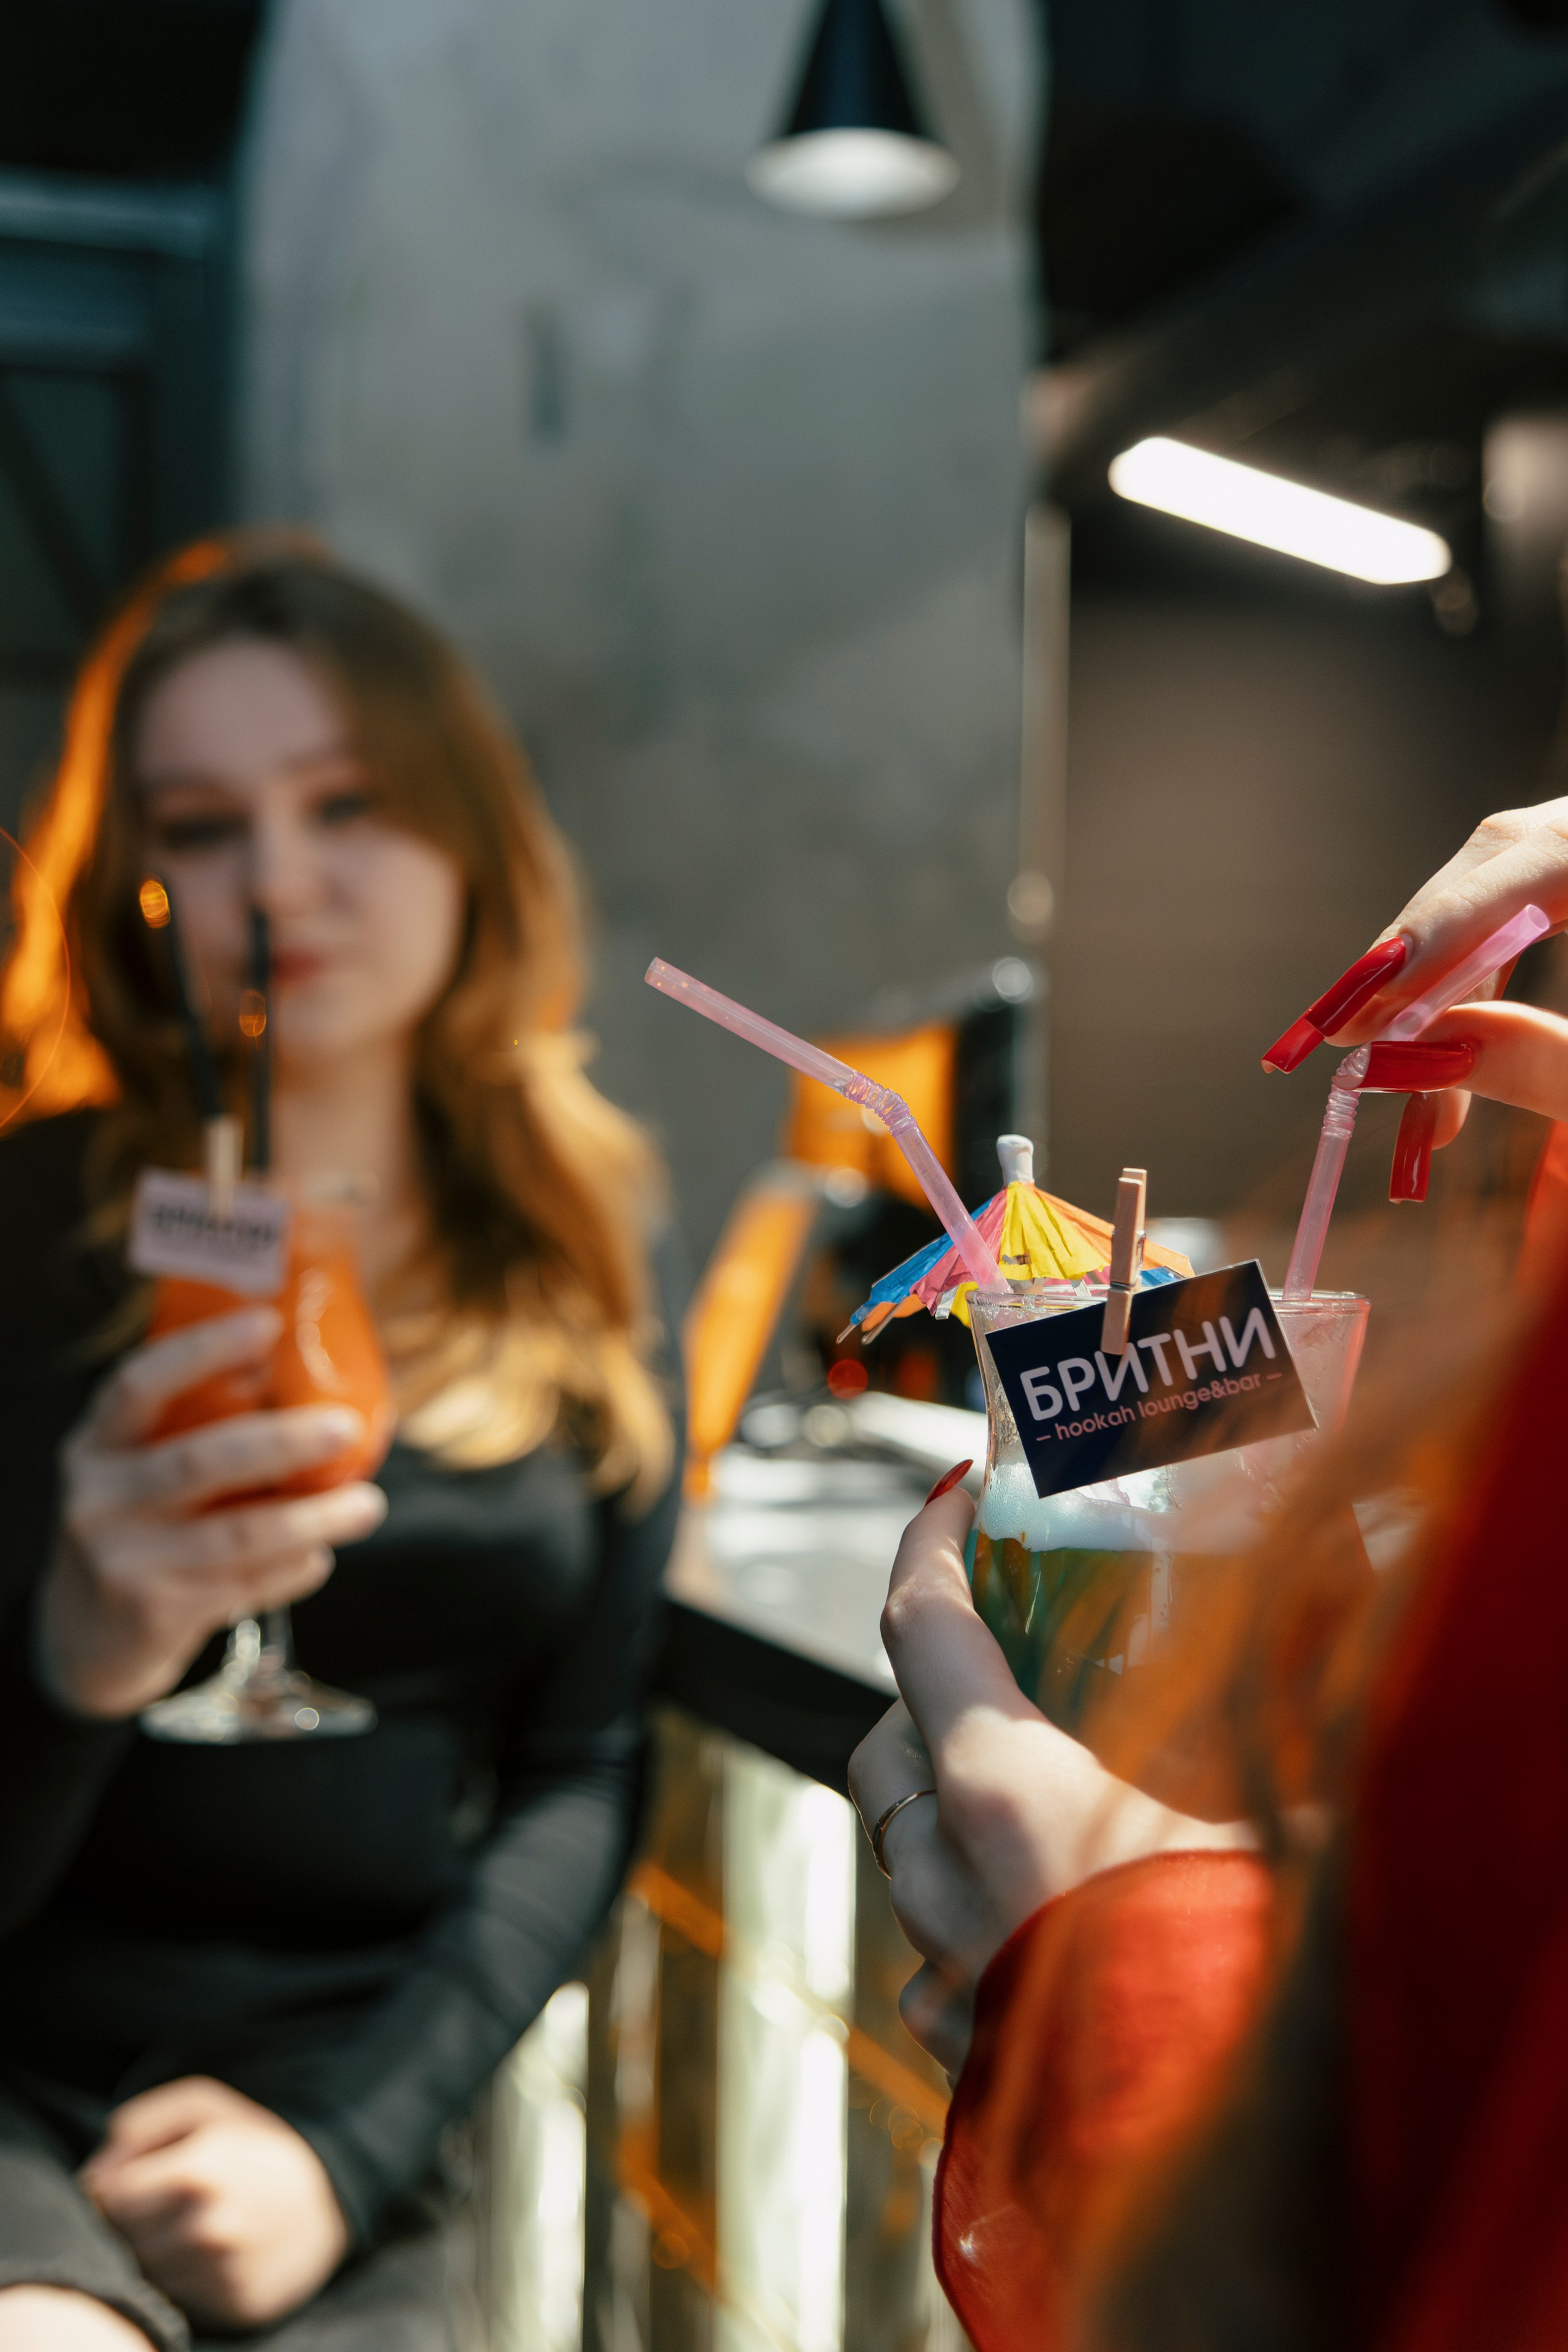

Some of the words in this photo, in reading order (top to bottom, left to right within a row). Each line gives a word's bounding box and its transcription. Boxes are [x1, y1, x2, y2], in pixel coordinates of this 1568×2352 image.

[1020, 1307, 1276, 1421] БРИТНИ
[1055, 1405, 1136, 1440] hookah
[1137, 1373, 1261, 1419] lounge&bar
